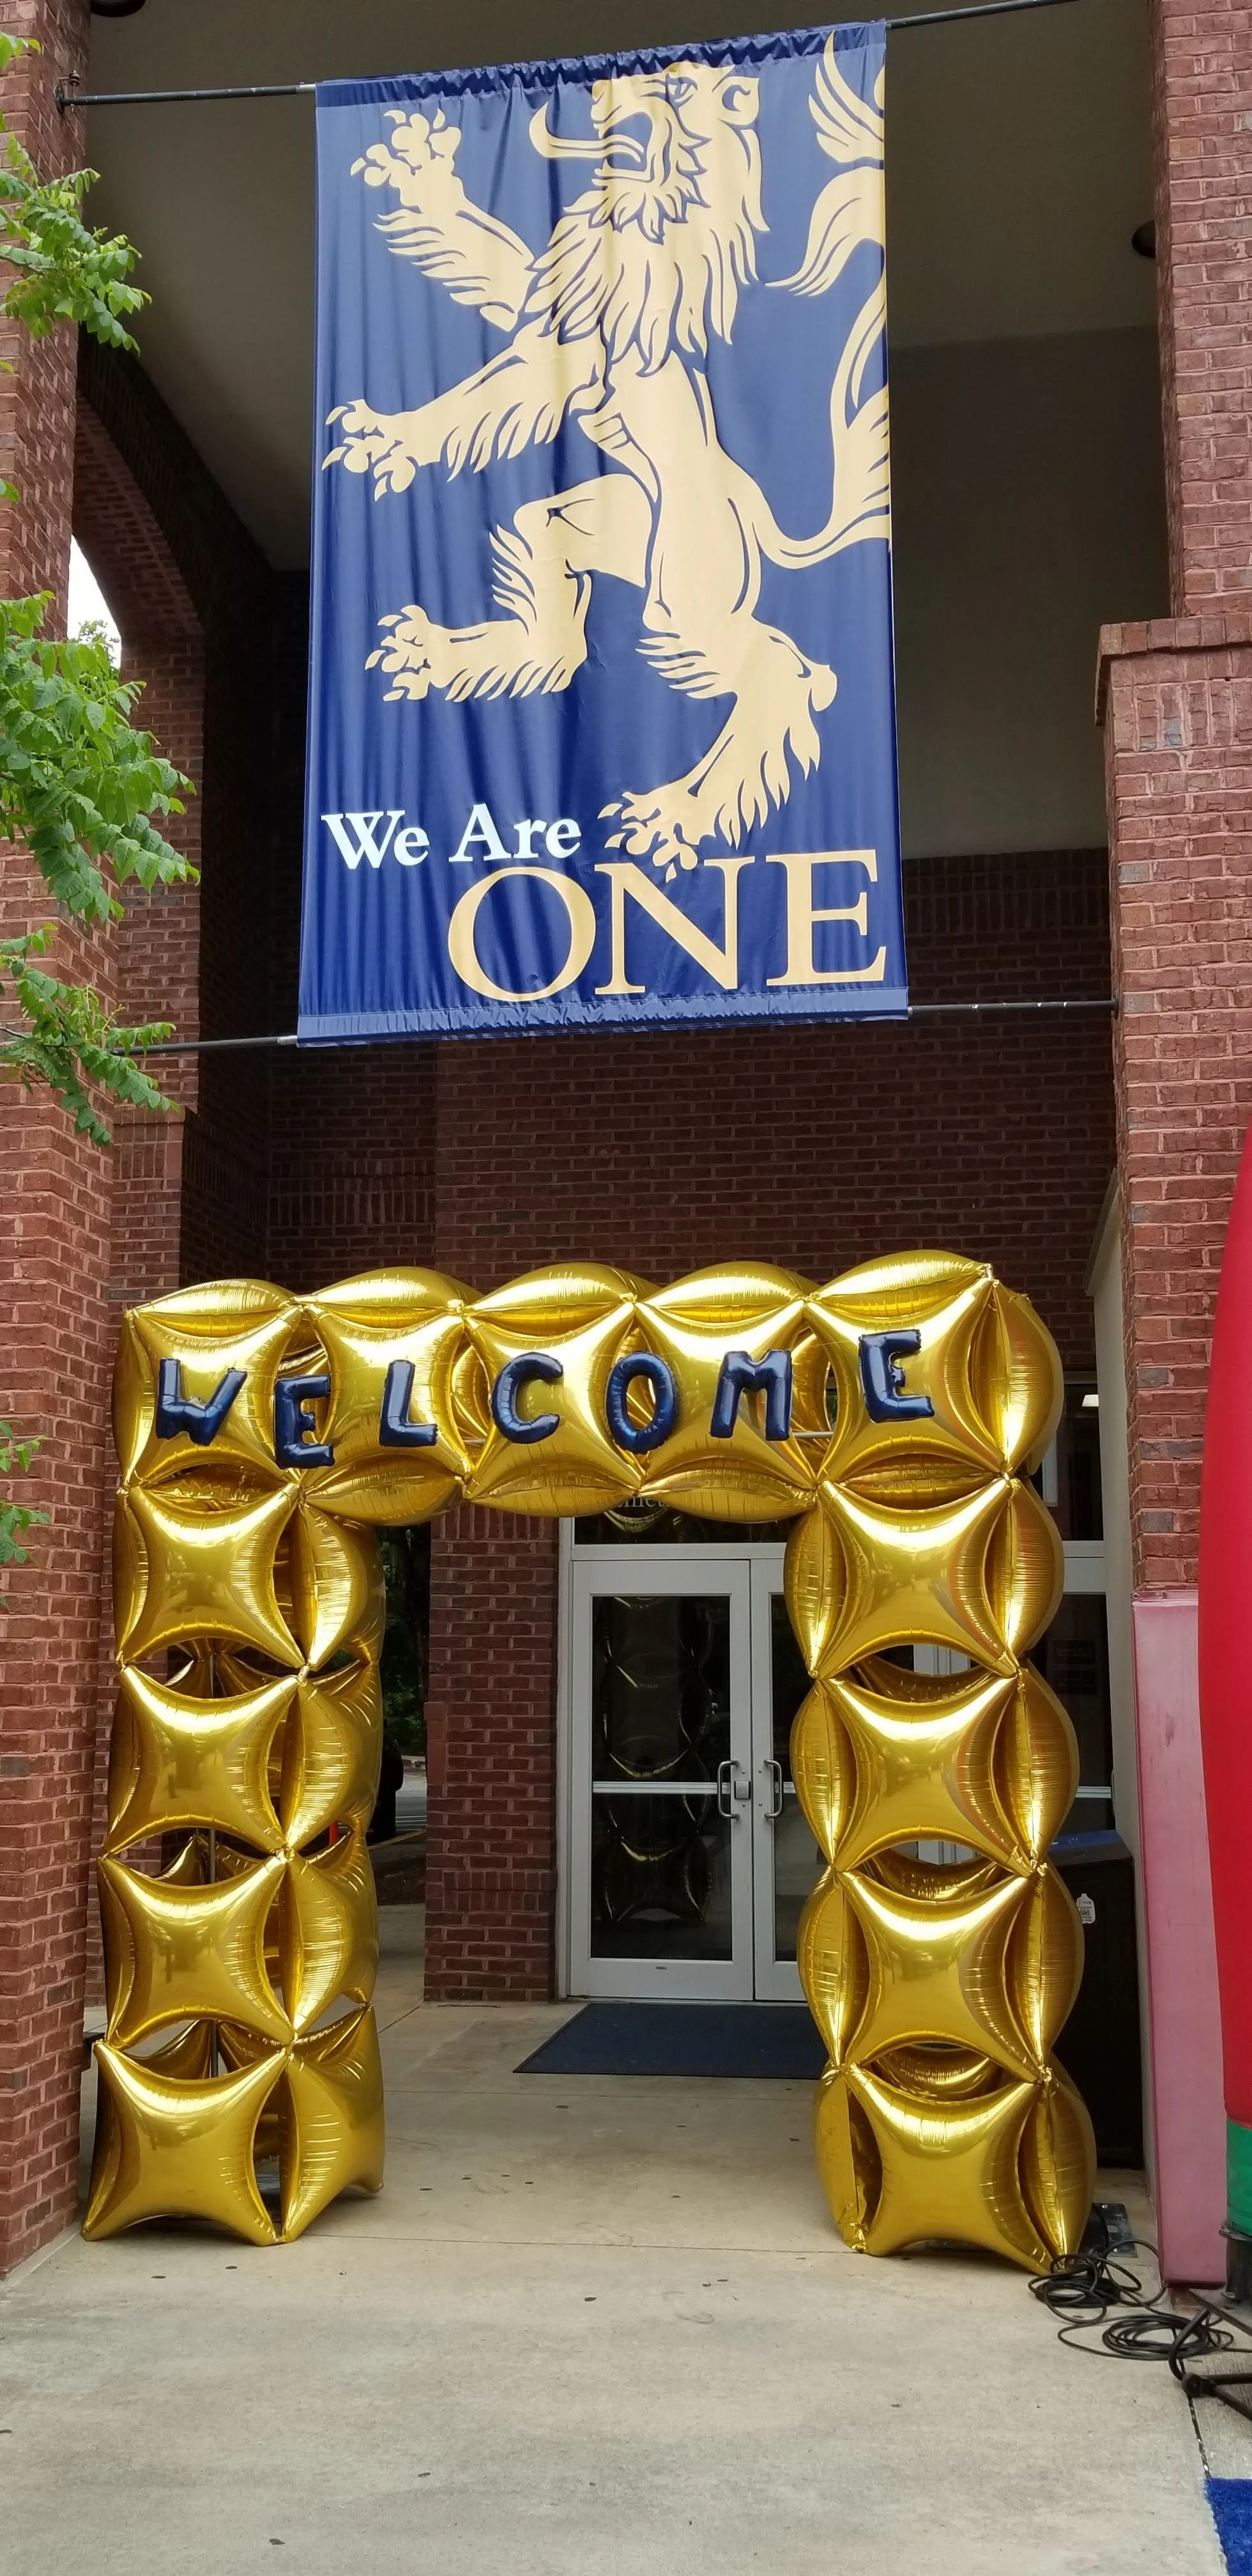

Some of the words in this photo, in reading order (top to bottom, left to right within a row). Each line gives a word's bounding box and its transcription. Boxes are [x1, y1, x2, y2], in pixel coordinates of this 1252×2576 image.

[321, 809, 430, 870] We
[448, 803, 581, 862] Are
[447, 848, 887, 1002] ONE
[155, 1329, 935, 1469] WELCOME
